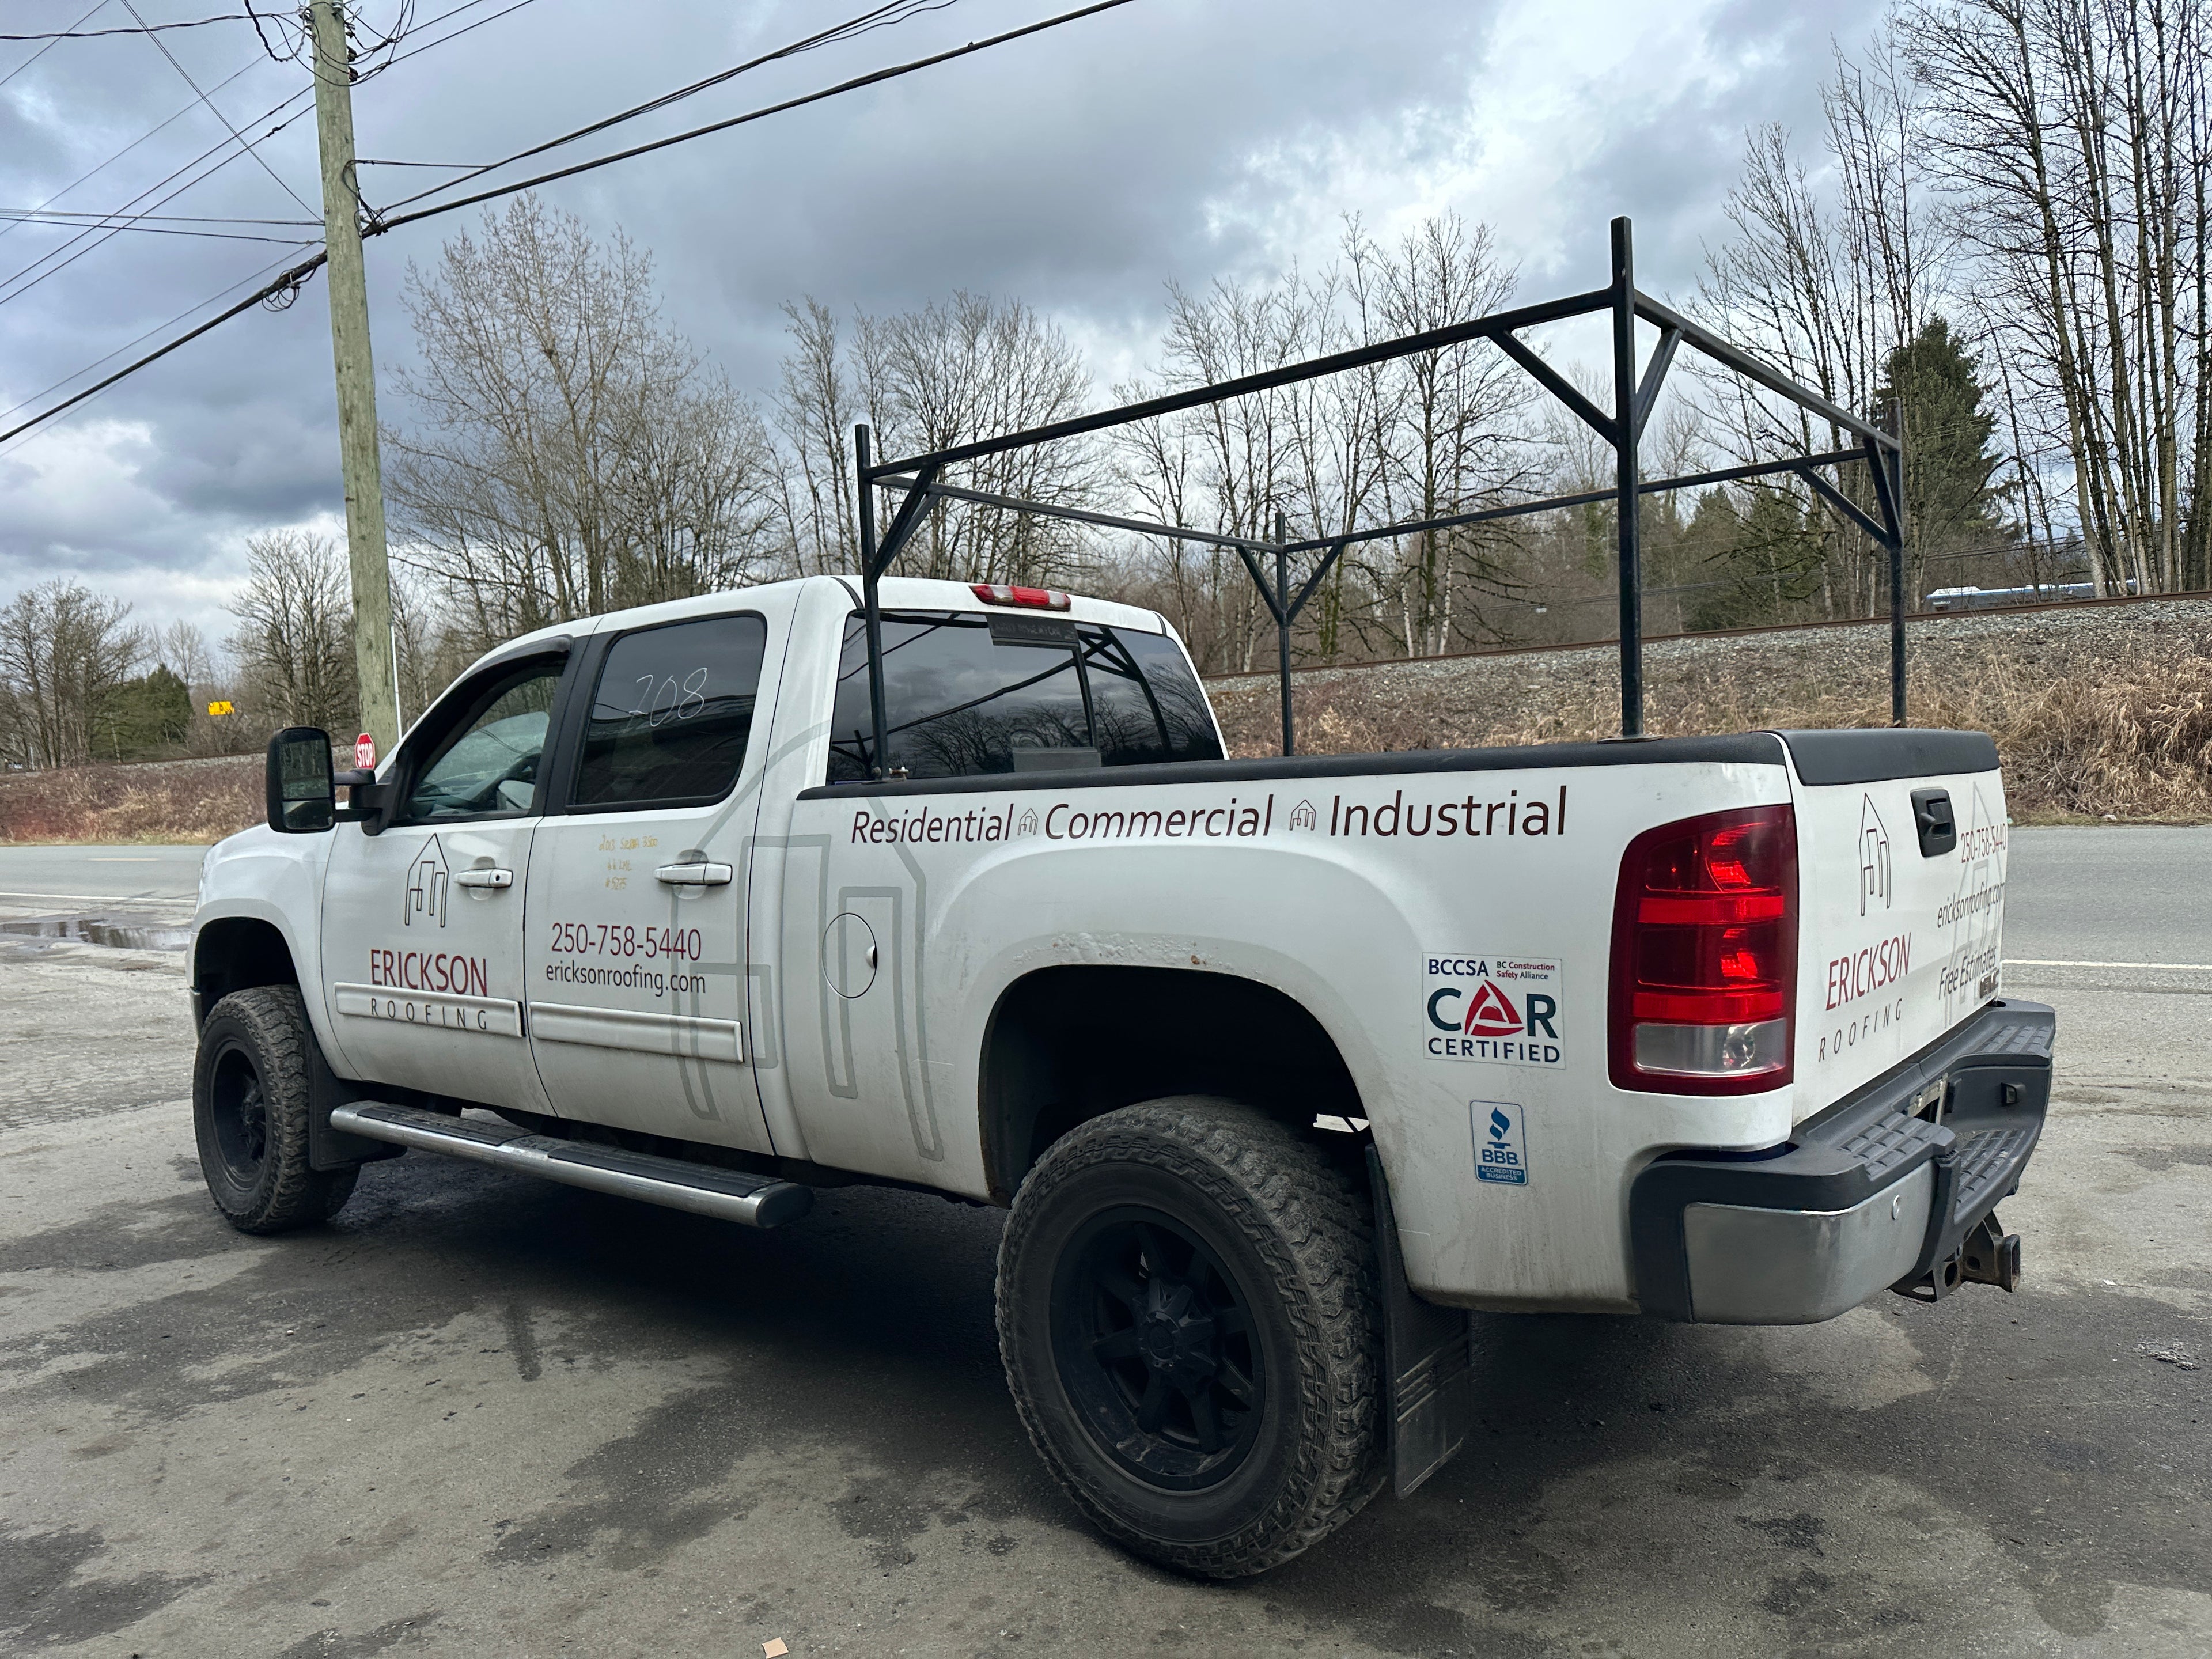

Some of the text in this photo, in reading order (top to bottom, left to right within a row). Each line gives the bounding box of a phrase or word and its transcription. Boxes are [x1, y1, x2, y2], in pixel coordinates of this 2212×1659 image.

[357, 742, 373, 768] STOP
[851, 785, 1567, 844] Residential Commercial Industrial
[1960, 823, 2006, 863] 250-758-5440
[1937, 881, 2005, 929] ericksonroofing.com
[551, 922, 702, 961] 250-758-5440
[370, 949, 488, 997] ERICKSON
[546, 960, 706, 997] ericksonroofing.com
[1429, 959, 1489, 976] BCCSA
[1509, 961, 1555, 971] Construction
[1497, 970, 1548, 980] Safety Alliance
[1825, 932, 1911, 1011] ERICKSON
[1938, 945, 1996, 1001] Free Estimates
[370, 998, 487, 1030] ROOFING
[1819, 998, 1903, 1063] ROOFING
[1428, 1037, 1560, 1063] CERTIFIED
[1481, 1167, 1521, 1176] ACCREDITED
[1482, 1149, 1518, 1165] BBB
[1486, 1172, 1517, 1181] BUSINESS
